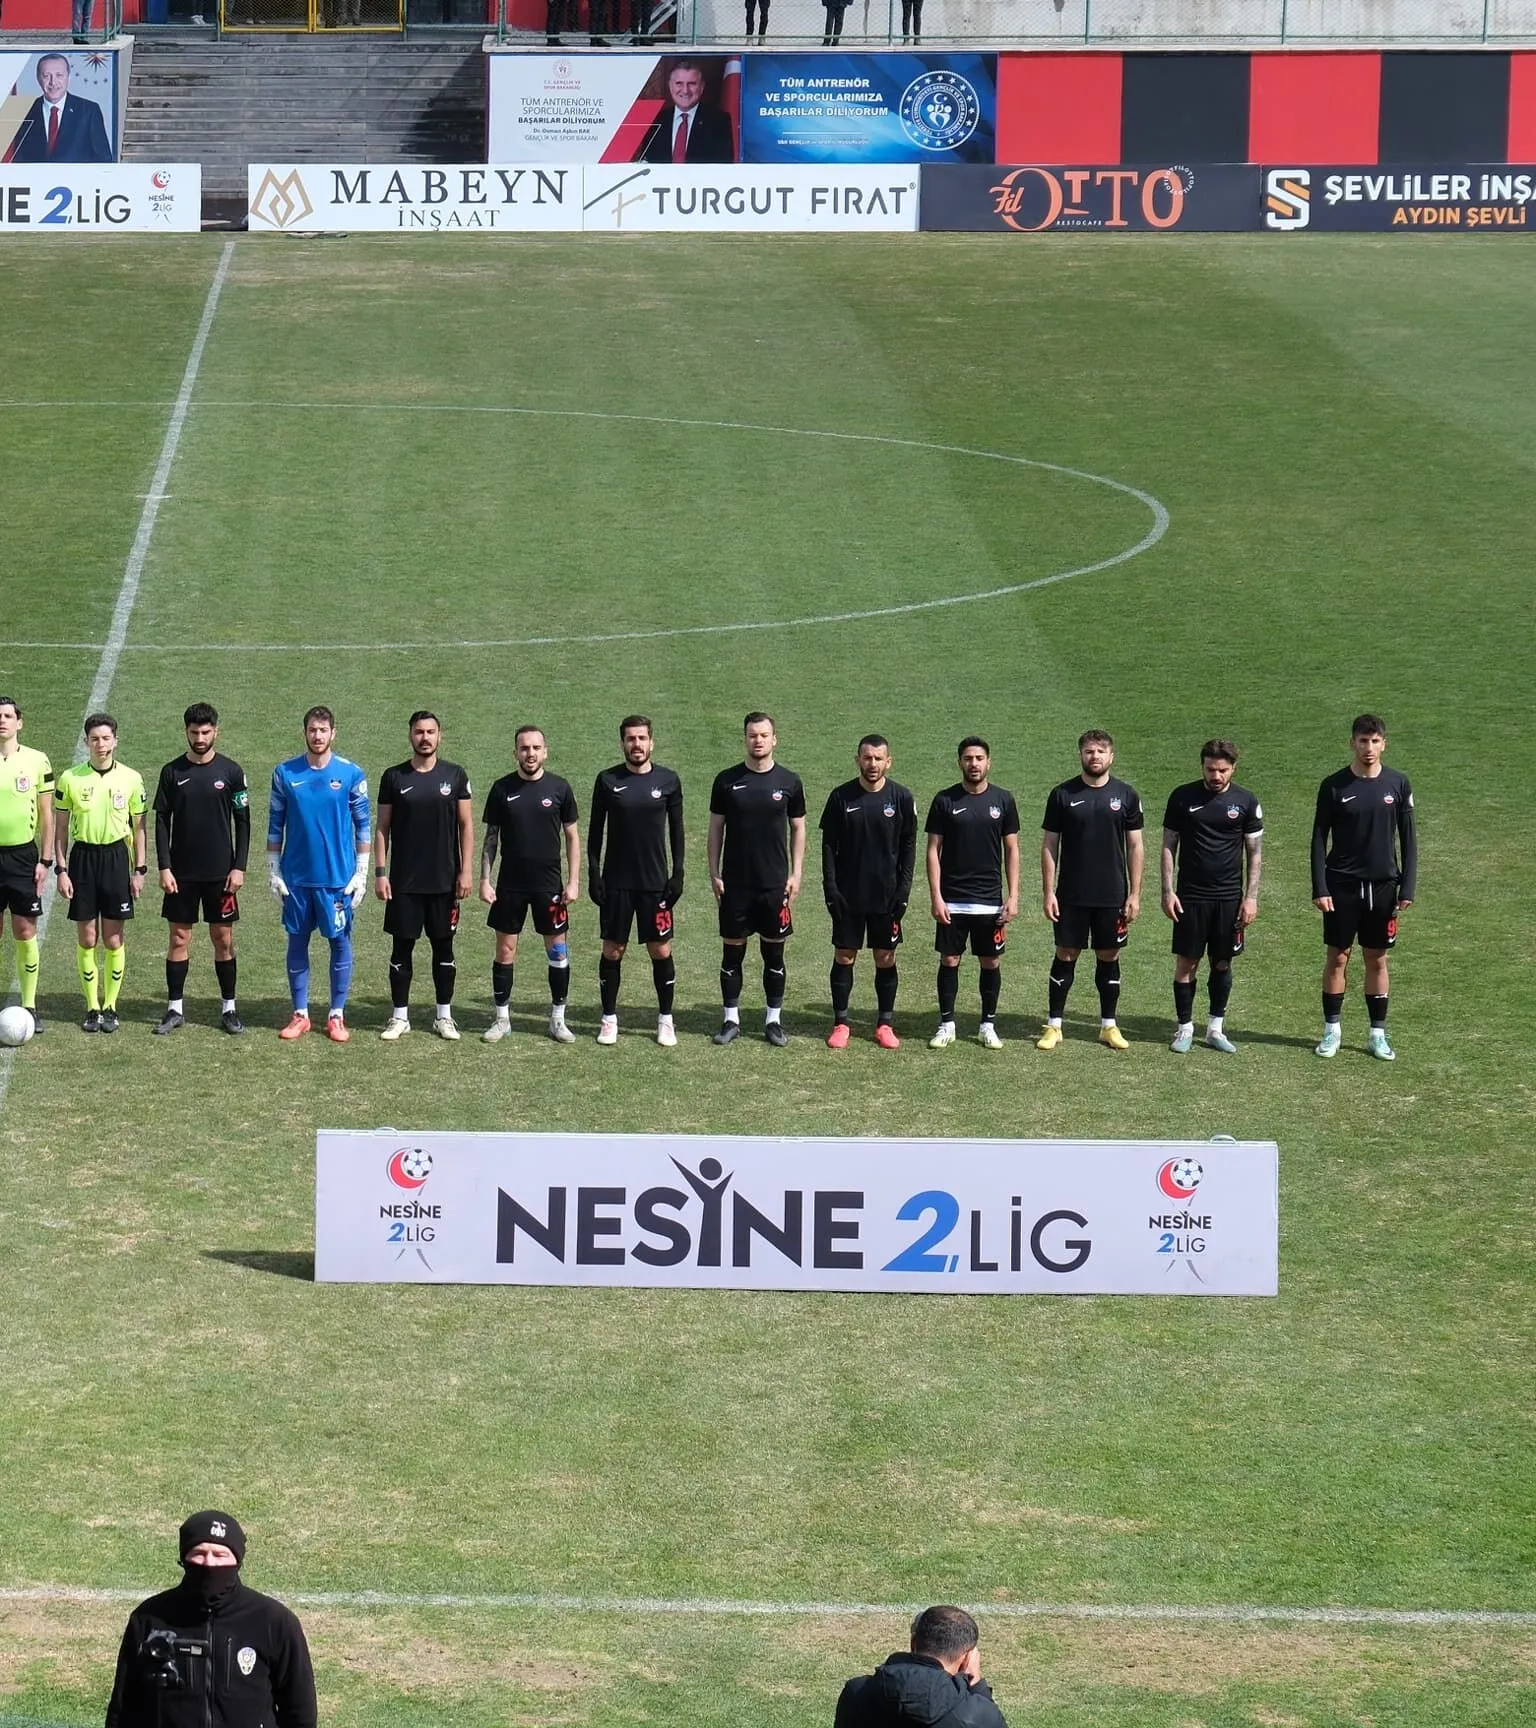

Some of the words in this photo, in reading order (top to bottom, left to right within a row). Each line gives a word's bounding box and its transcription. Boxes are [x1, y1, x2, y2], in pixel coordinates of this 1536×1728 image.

[779, 77, 804, 88] TÜM
[807, 77, 870, 88] ANTRENÖR
[520, 97, 540, 106] TÜM
[592, 98, 604, 107] VE
[765, 93, 780, 102] VE
[783, 93, 883, 102] SPORCULARIMIZA
[523, 107, 601, 116] SPORCULARIMIZA
[759, 107, 823, 118] BAŞARILAR
[826, 105, 889, 116] DİLİYORUM
[518, 117, 561, 125] BAŞARILAR
[562, 116, 605, 125] DİLİYORUM
[330, 169, 569, 204] MABEYN
[652, 187, 794, 215] TURGUT
[1000, 167, 1184, 231] OTTO
[398, 206, 500, 231] İNŞAAT
[1392, 207, 1461, 225] AYDIN
[655, 910, 677, 931] 53
